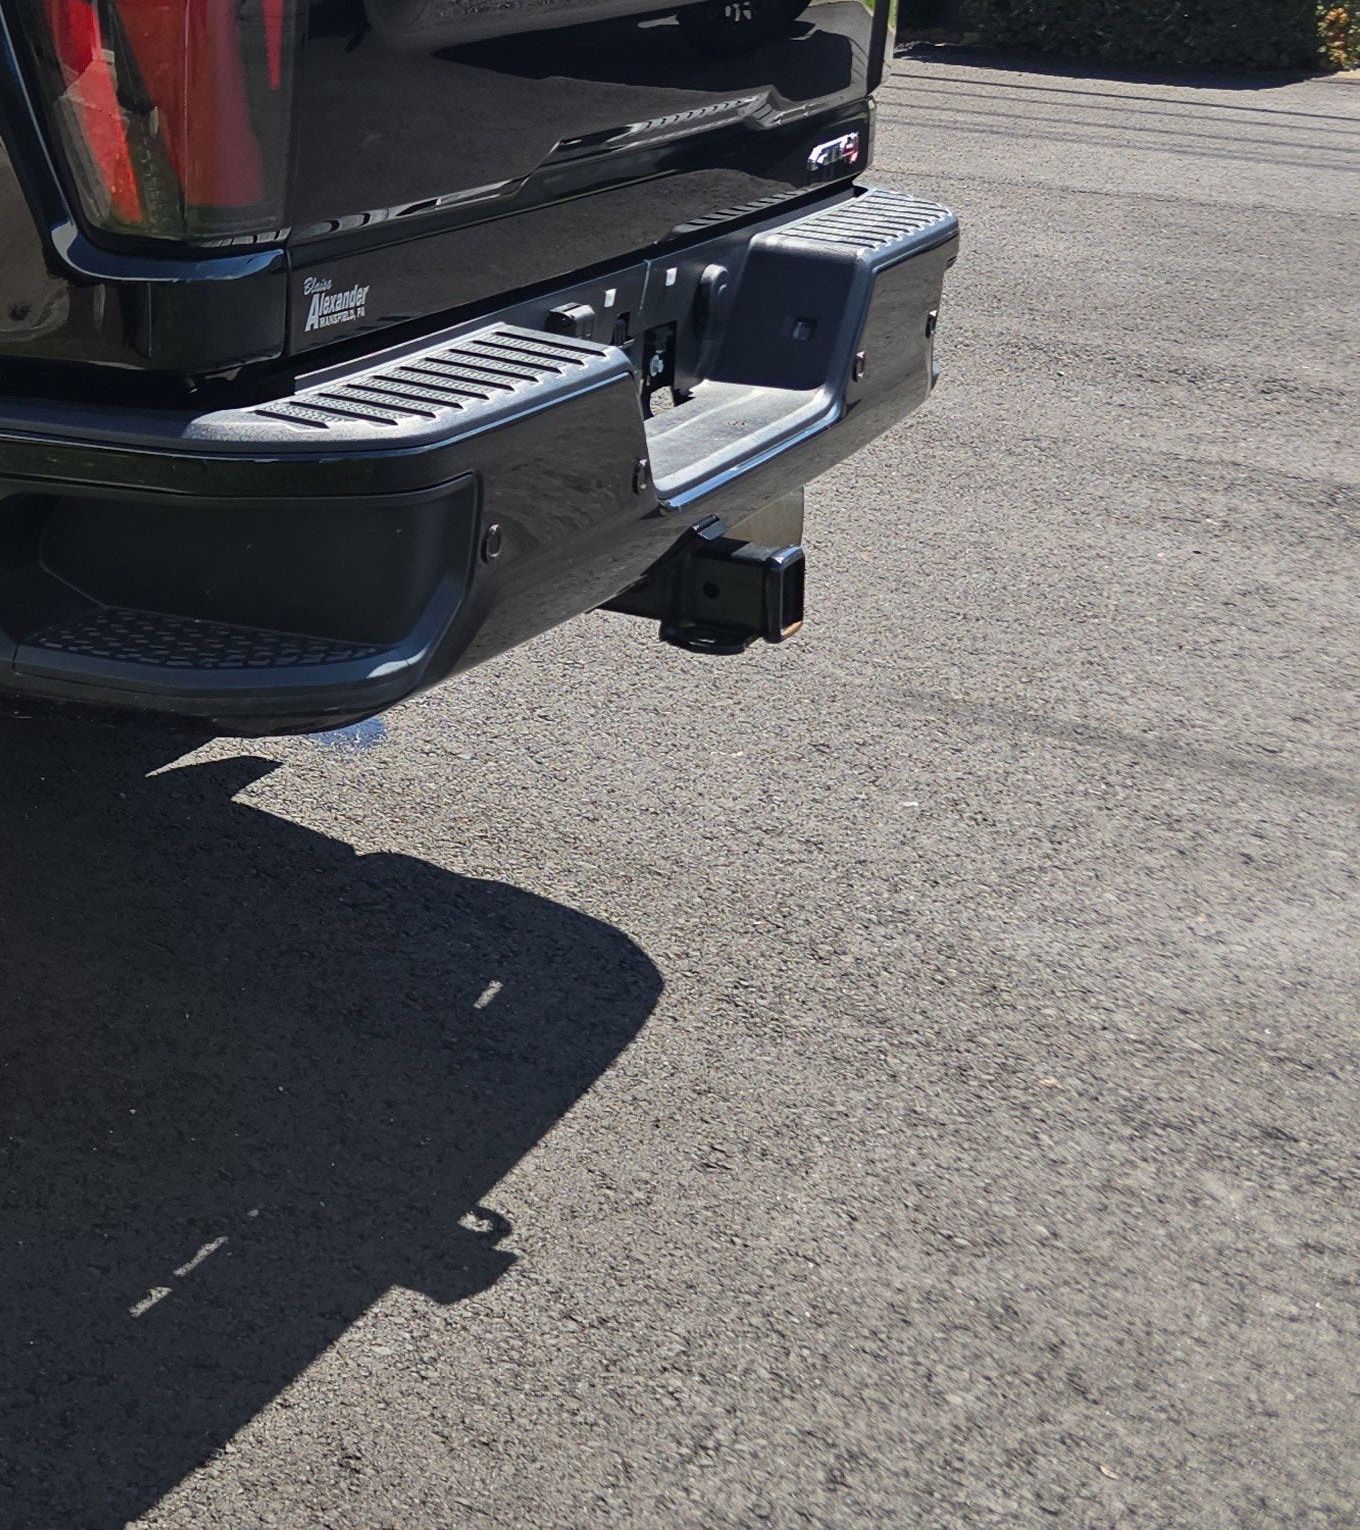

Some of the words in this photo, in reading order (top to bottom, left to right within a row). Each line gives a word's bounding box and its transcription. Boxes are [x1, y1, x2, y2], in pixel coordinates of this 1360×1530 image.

[808, 131, 859, 170] AT4
[303, 276, 333, 296] Blaise
[304, 284, 370, 332] Alexander
